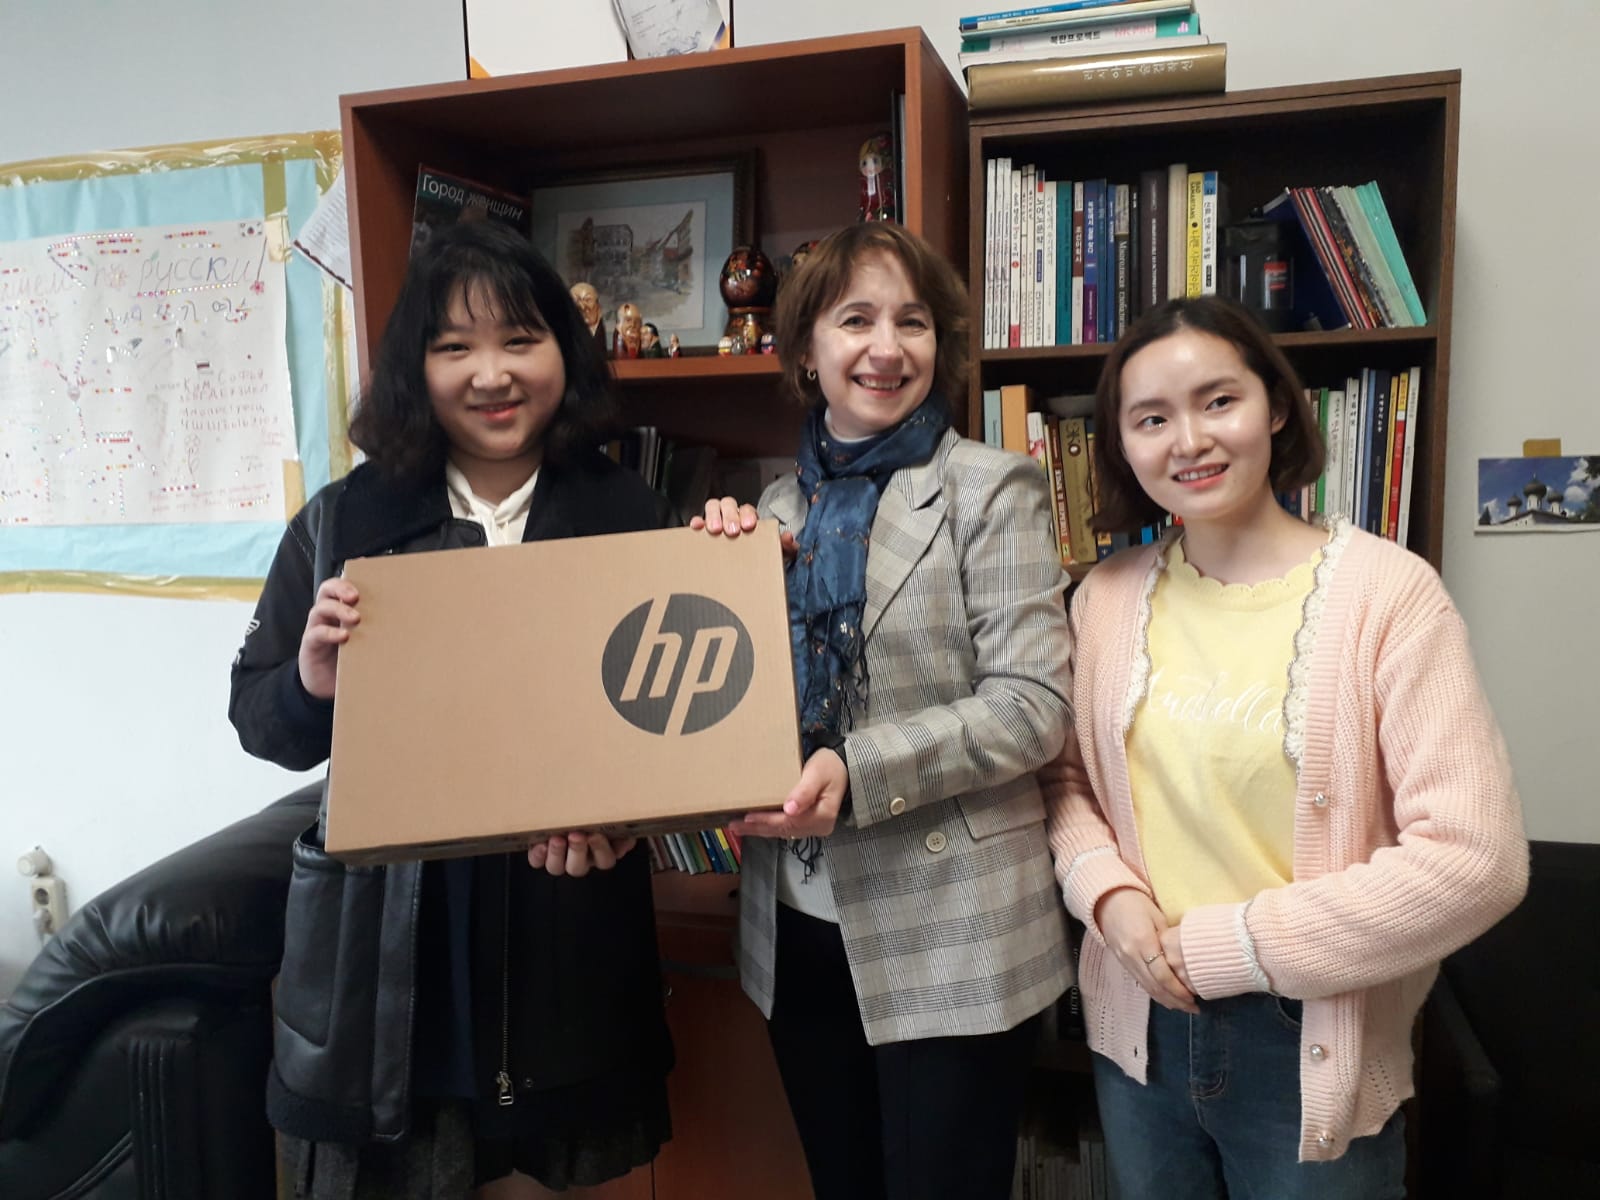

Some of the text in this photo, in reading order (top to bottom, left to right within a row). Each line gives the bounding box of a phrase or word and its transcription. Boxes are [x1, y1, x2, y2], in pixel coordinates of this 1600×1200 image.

[422, 174, 524, 222] Город женщин
[1188, 250, 1200, 297] 사마리아인
[619, 593, 739, 736] hp
